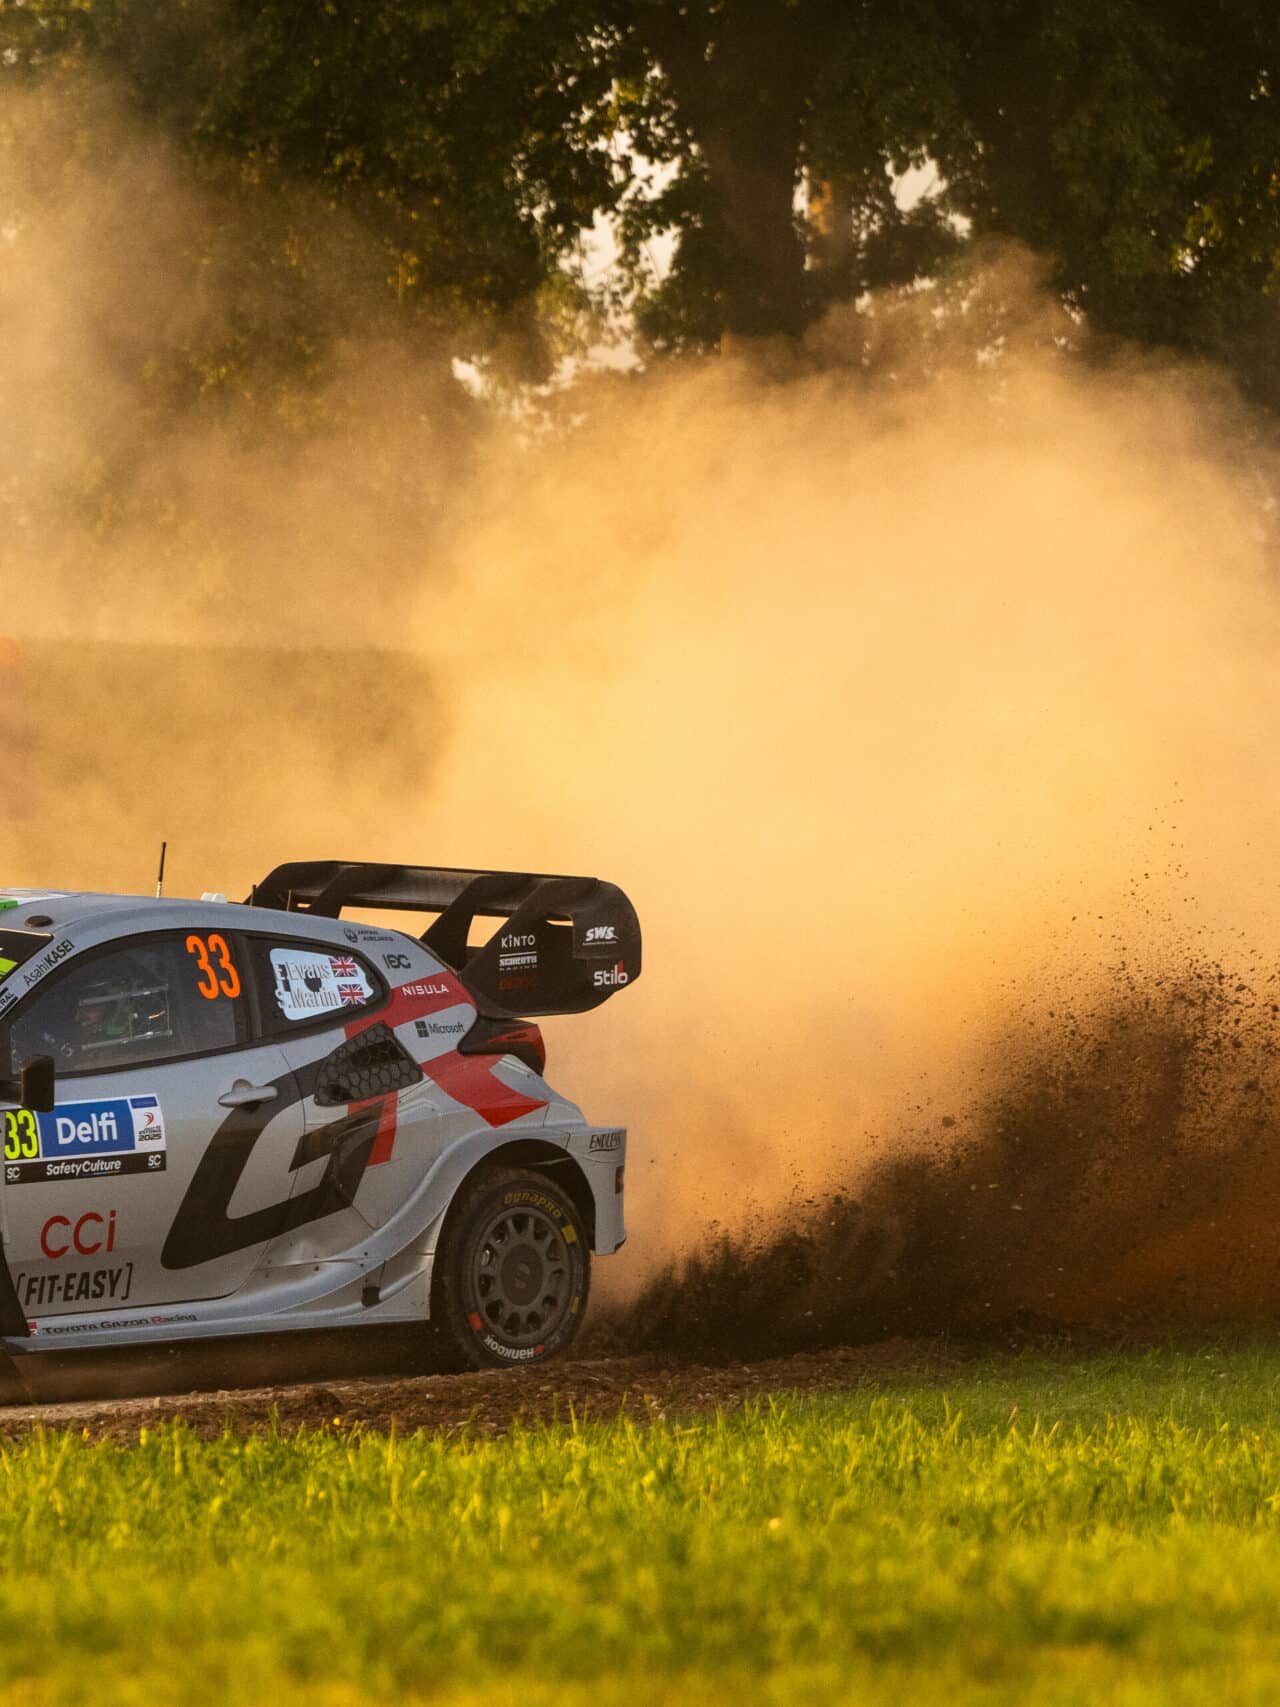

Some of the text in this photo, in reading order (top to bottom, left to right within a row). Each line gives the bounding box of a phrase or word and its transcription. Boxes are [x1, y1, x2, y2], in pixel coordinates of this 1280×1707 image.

[585, 926, 616, 941] SWS
[23, 938, 75, 987] AsahiKASEI
[185, 934, 241, 1000] 33
[593, 963, 628, 986] Stilo
[402, 984, 449, 996] NISULA
[428, 1022, 465, 1035] Microsoft
[5, 1110, 118, 1160] 33 Delfi
[6, 1154, 161, 1180] SC SafetyCulture SC
[42, 1323, 97, 1335] TOYOTA
[100, 1318, 149, 1329] GAZOO
[150, 1313, 197, 1325] Racing
